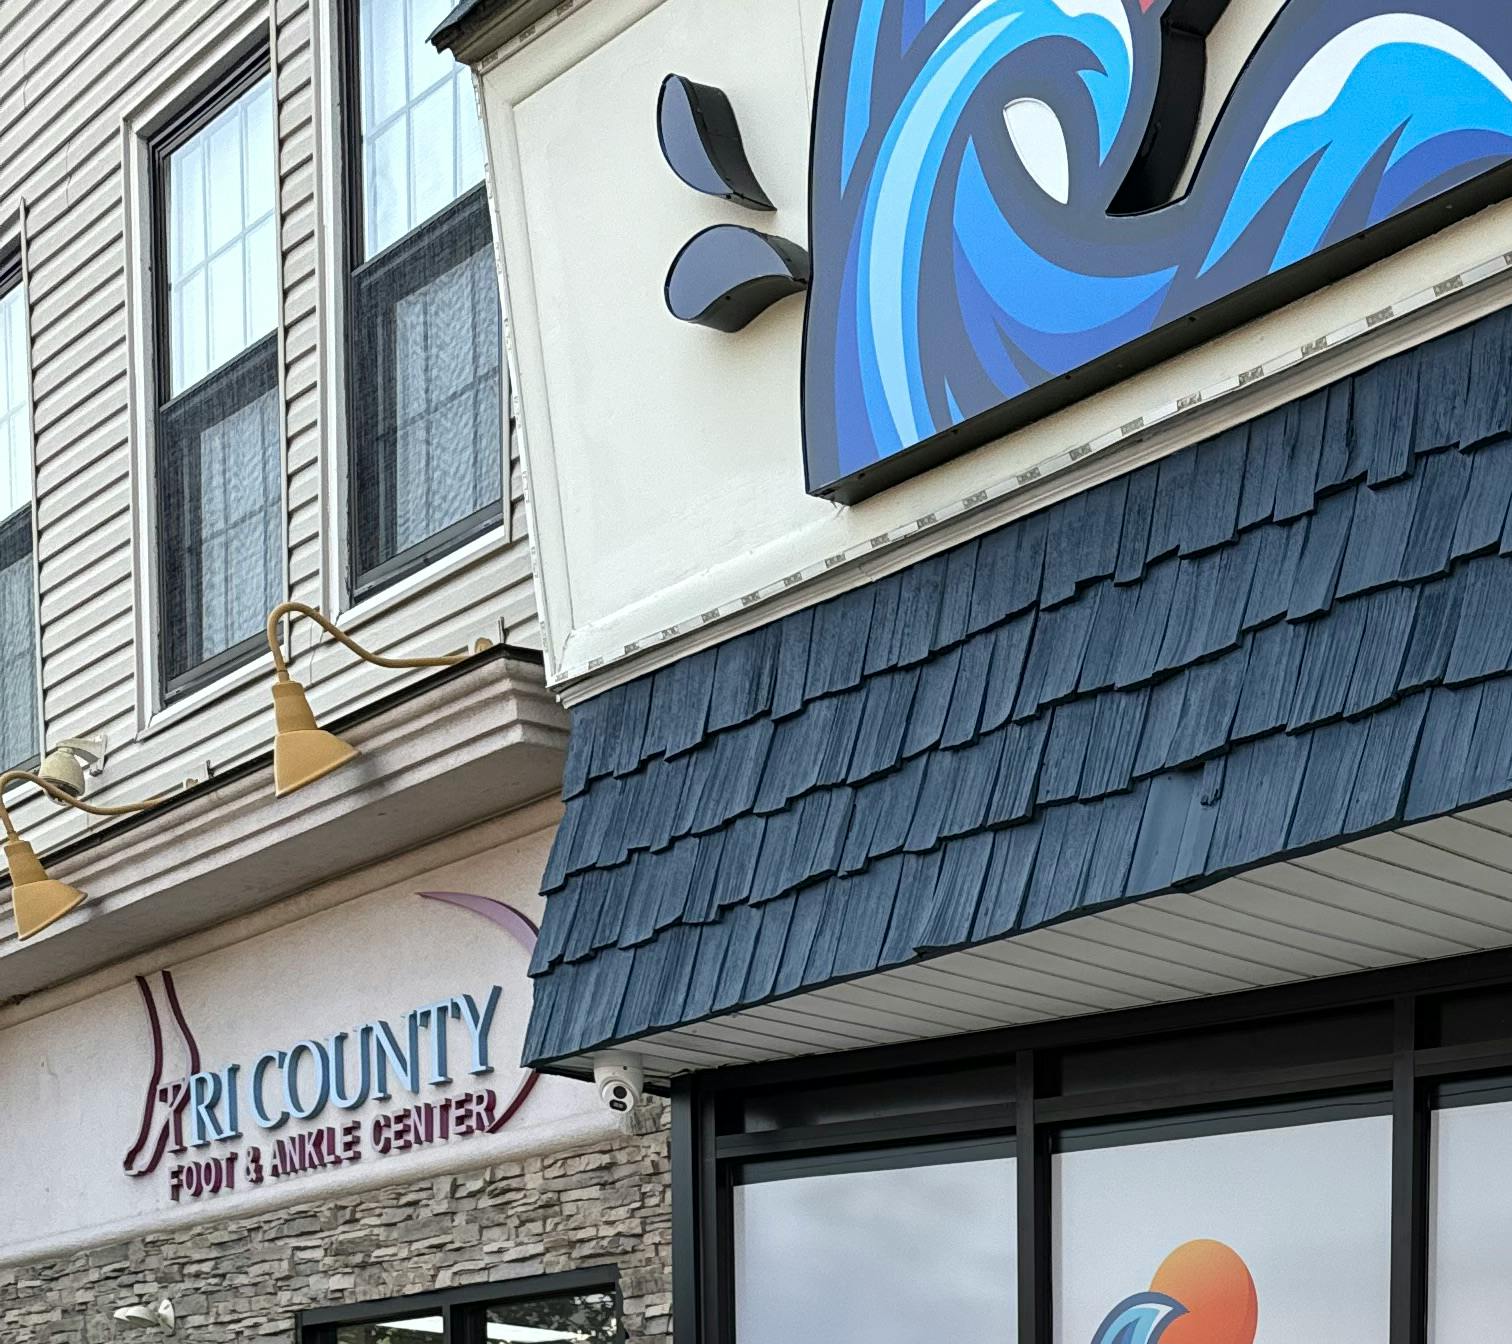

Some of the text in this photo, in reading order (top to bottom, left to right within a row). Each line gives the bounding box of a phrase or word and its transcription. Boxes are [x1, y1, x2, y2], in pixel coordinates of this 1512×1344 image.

[159, 985, 502, 1152] TRI COUNTY
[169, 1089, 496, 1200] FOOT & ANKLE CENTER
